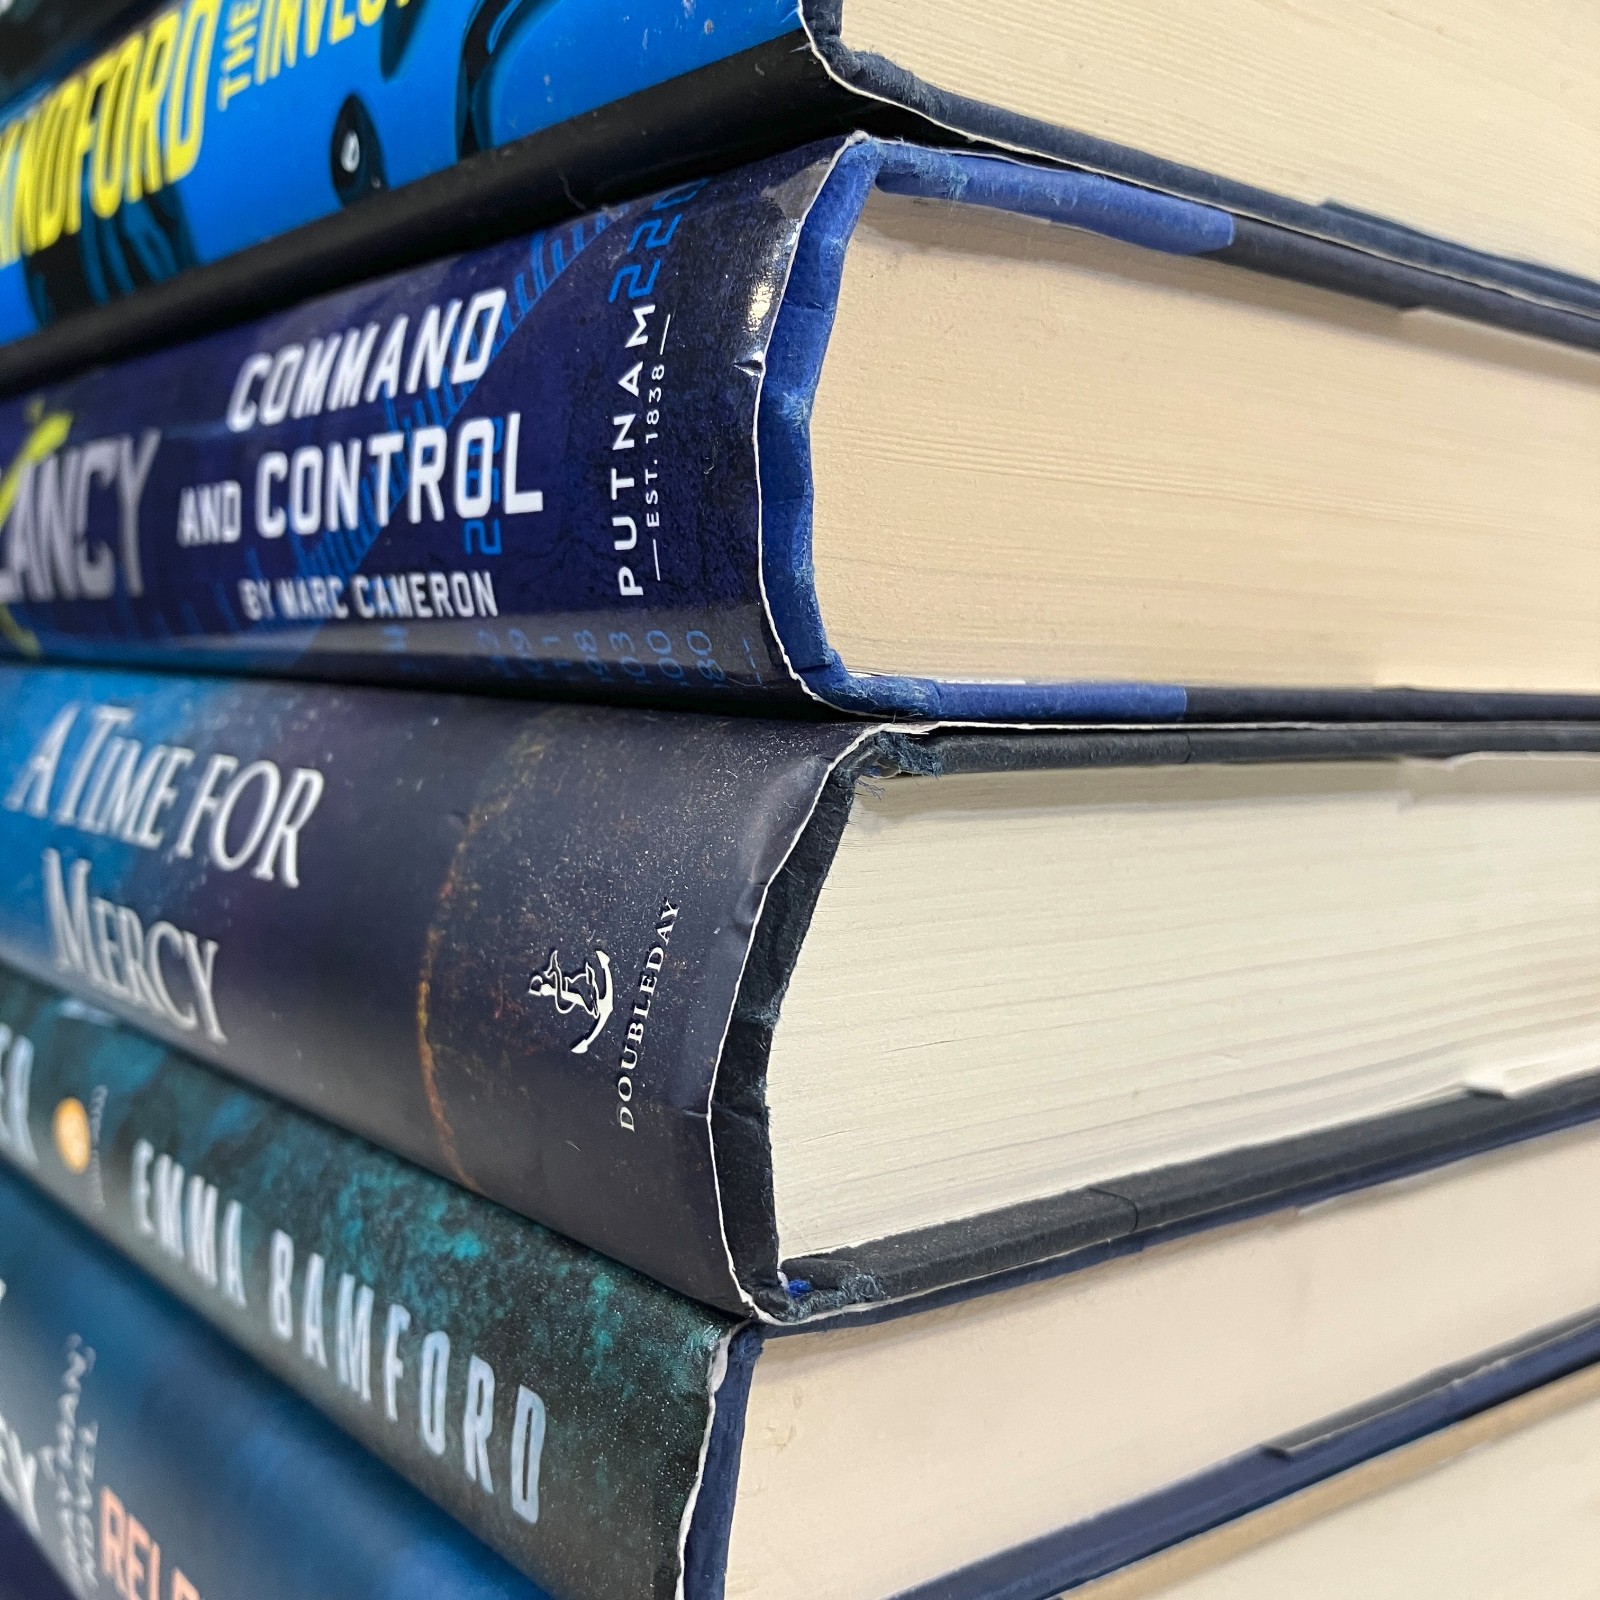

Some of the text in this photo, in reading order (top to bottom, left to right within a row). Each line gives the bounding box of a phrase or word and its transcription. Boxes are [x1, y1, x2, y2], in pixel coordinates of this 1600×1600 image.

[226, 287, 507, 432] COMMAND
[645, 363, 665, 528] EST. 1838
[0, 426, 162, 600] ANCY
[177, 482, 242, 547] AND
[255, 411, 544, 538] CONTROL
[610, 304, 656, 596] PUTNAM
[238, 571, 499, 621] BY MARC CAMERON
[8, 704, 325, 890] A TIME FOR
[41, 848, 228, 1046] MERCY
[618, 899, 680, 1132] DOUBLEDAY
[132, 1138, 247, 1308] EMMA
[267, 1229, 547, 1525] BAMFORD
